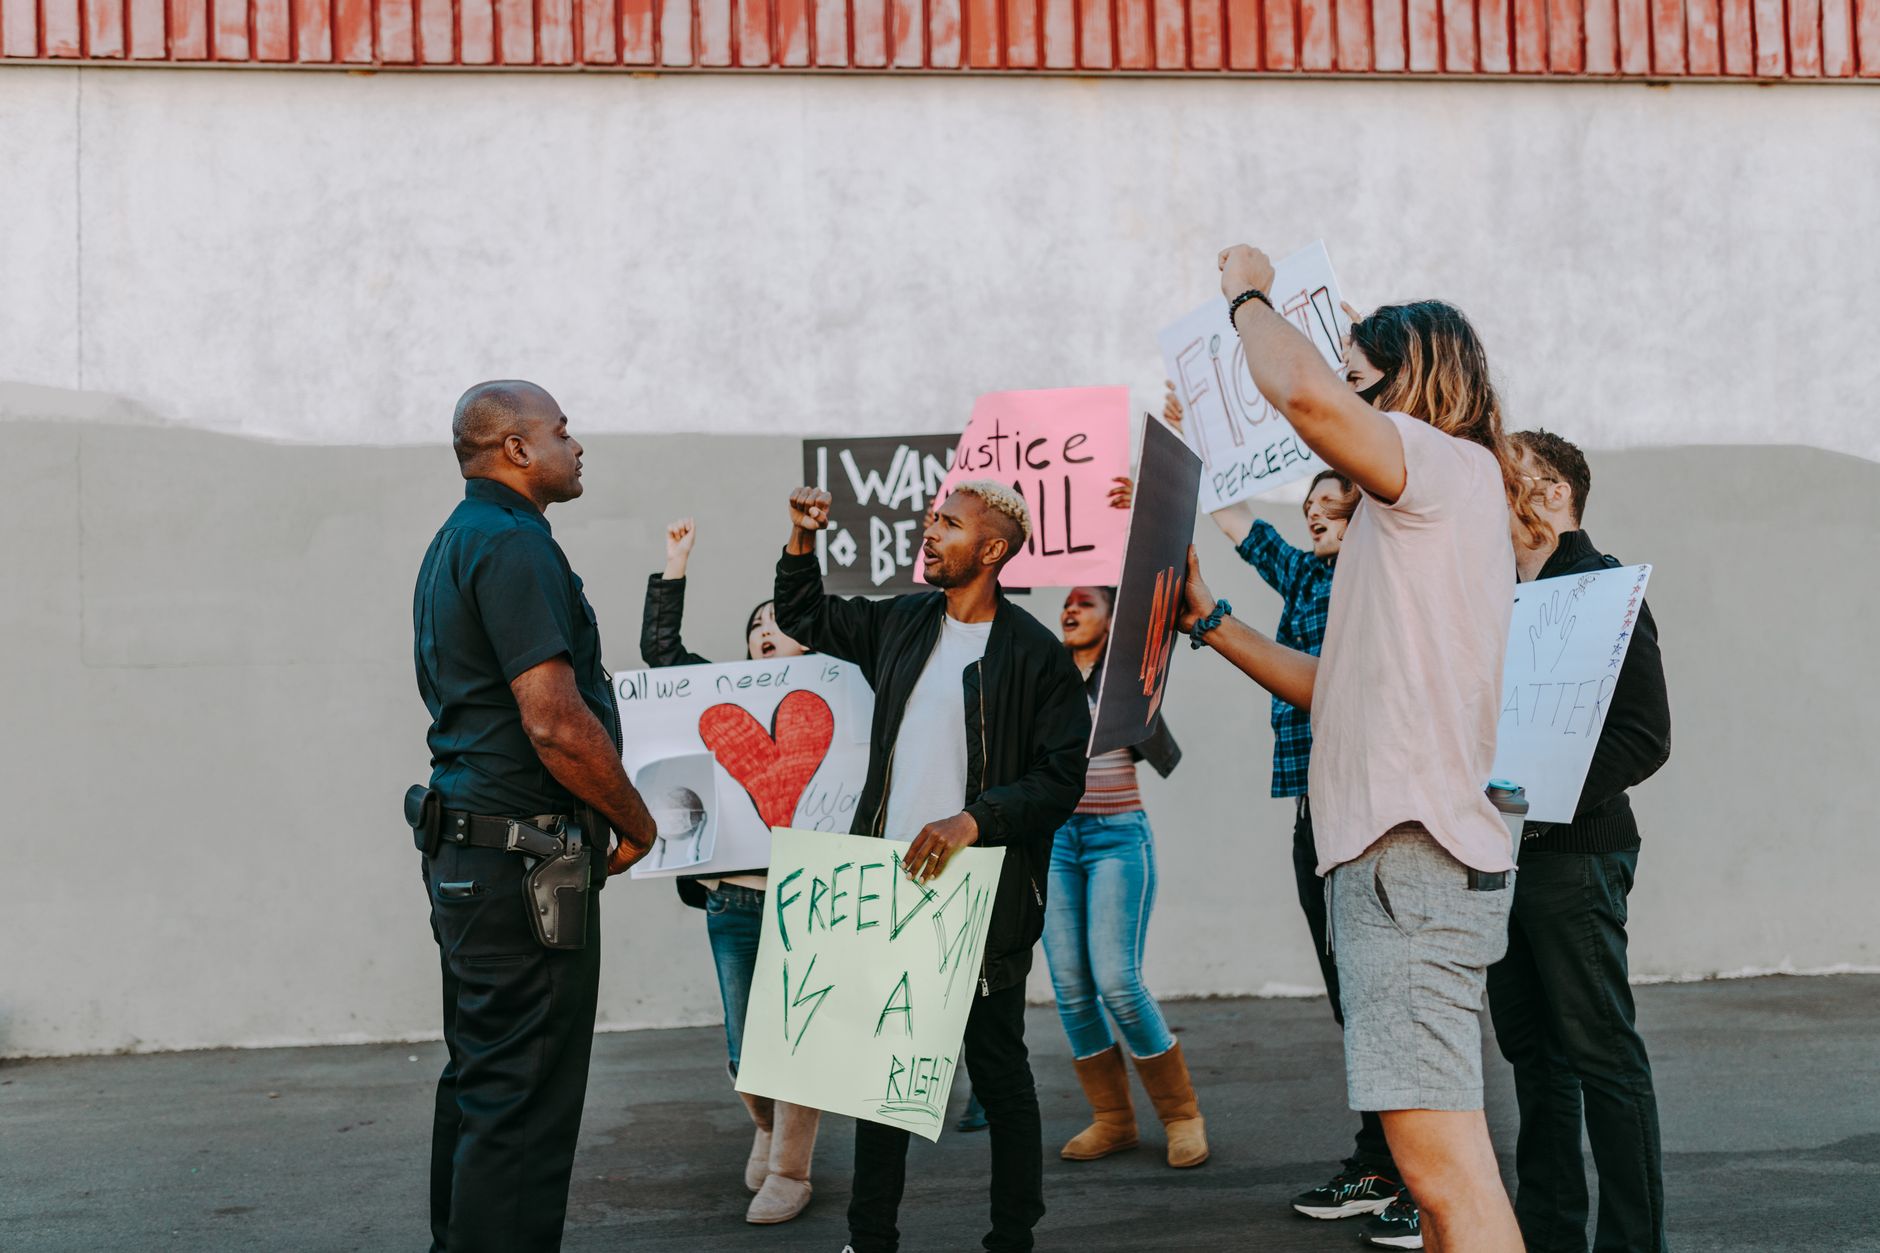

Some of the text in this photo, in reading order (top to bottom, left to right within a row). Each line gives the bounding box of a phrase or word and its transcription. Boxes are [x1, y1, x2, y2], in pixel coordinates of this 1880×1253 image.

[816, 444, 957, 512] I WAN
[869, 515, 917, 587] BE
[619, 664, 840, 700] all we need is
[1497, 674, 1617, 739] ATTER
[799, 782, 862, 818] Wa
[776, 850, 990, 1010] FREEDOM
[873, 970, 913, 1040] A
[886, 1054, 956, 1105] RIGHT
